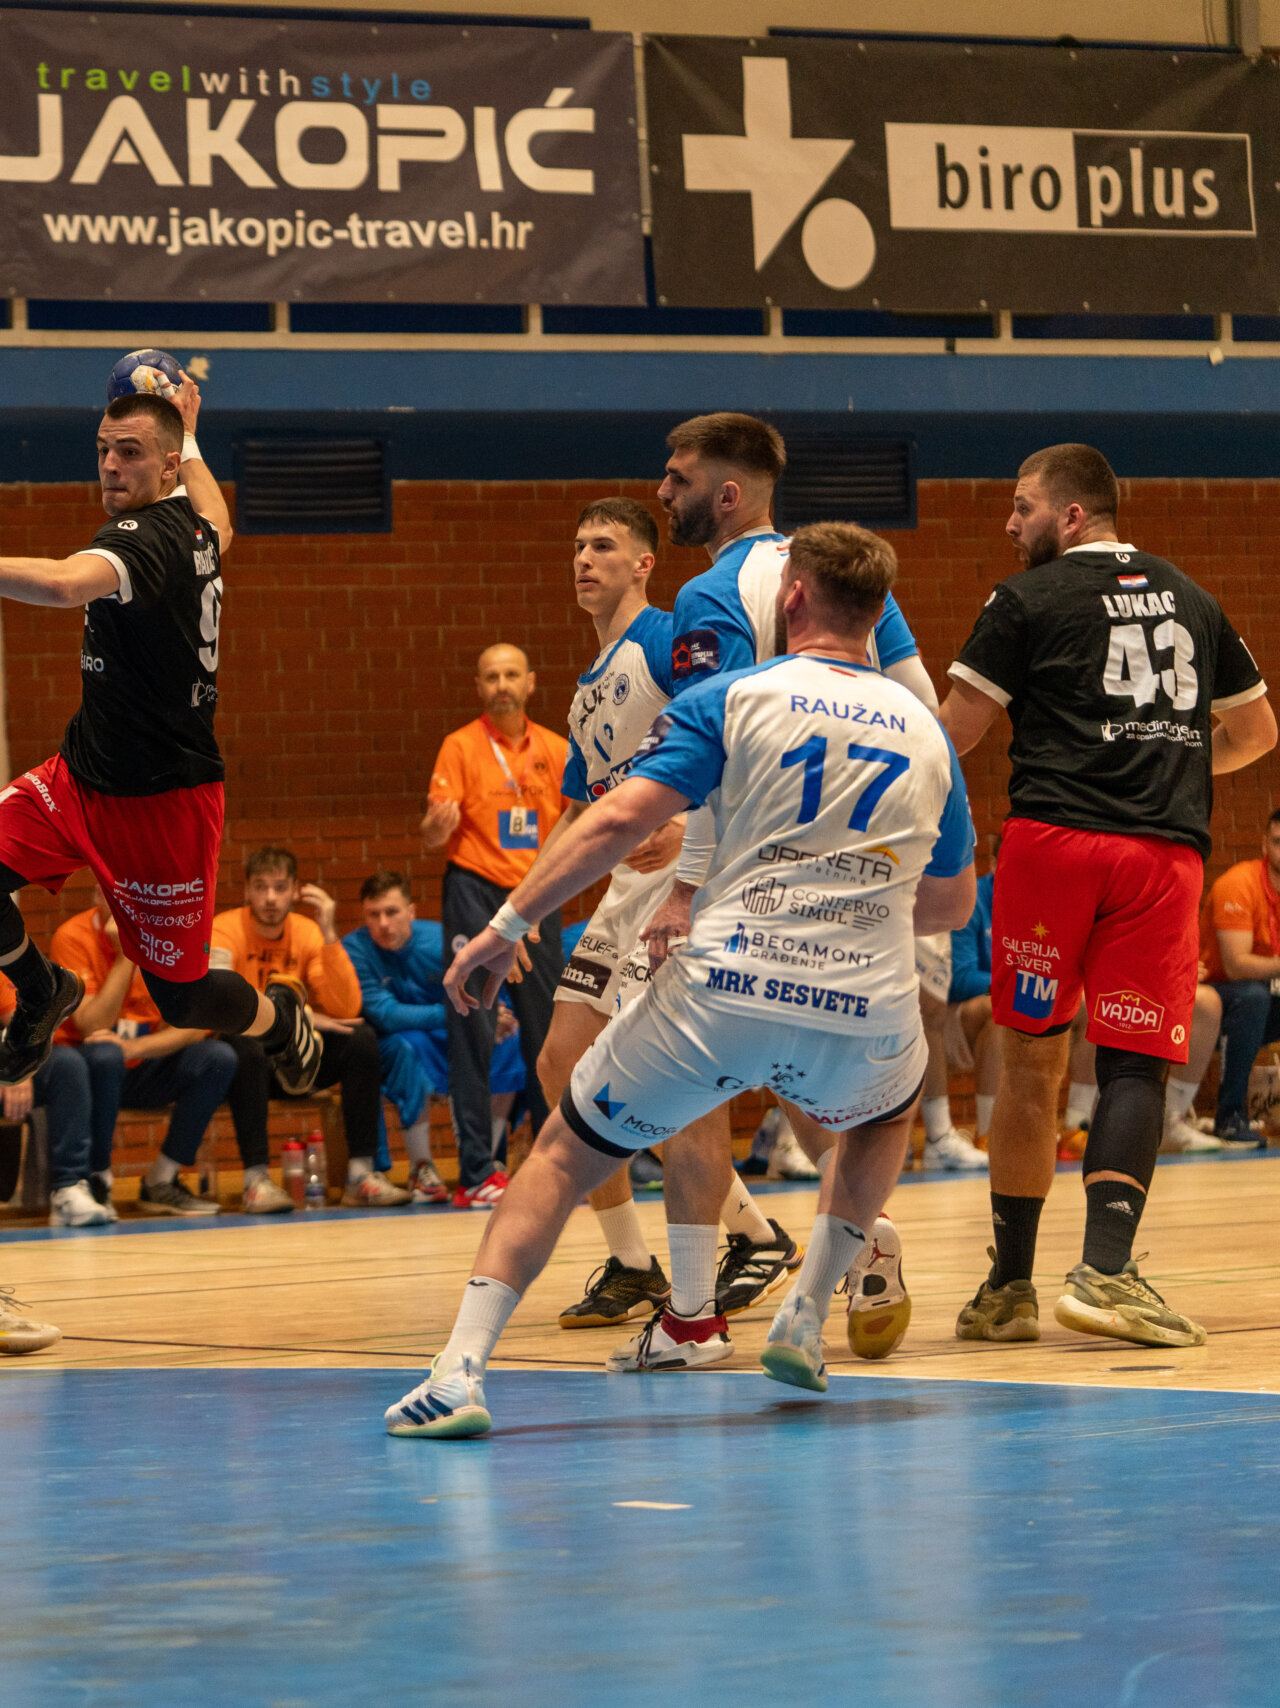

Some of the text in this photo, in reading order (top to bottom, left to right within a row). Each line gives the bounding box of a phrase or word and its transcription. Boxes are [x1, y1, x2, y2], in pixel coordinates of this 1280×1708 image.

[934, 142, 1220, 228] biro plus
[42, 206, 534, 257] www.jakopic-travel.hr
[1102, 618, 1199, 711] 43
[790, 695, 906, 734] RAUŽAN
[780, 734, 911, 833] 17
[114, 877, 204, 897] JAKOPIĆ
[792, 888, 890, 919] CONFERVO
[788, 902, 847, 925] SIMUL
[750, 948, 825, 971] GRAĐENJE
[752, 932, 874, 968] BEGAMONT
[705, 967, 870, 1019] MRK SESVETE
[1017, 968, 1059, 1002] TM
[1101, 1000, 1157, 1028] VAJDA
